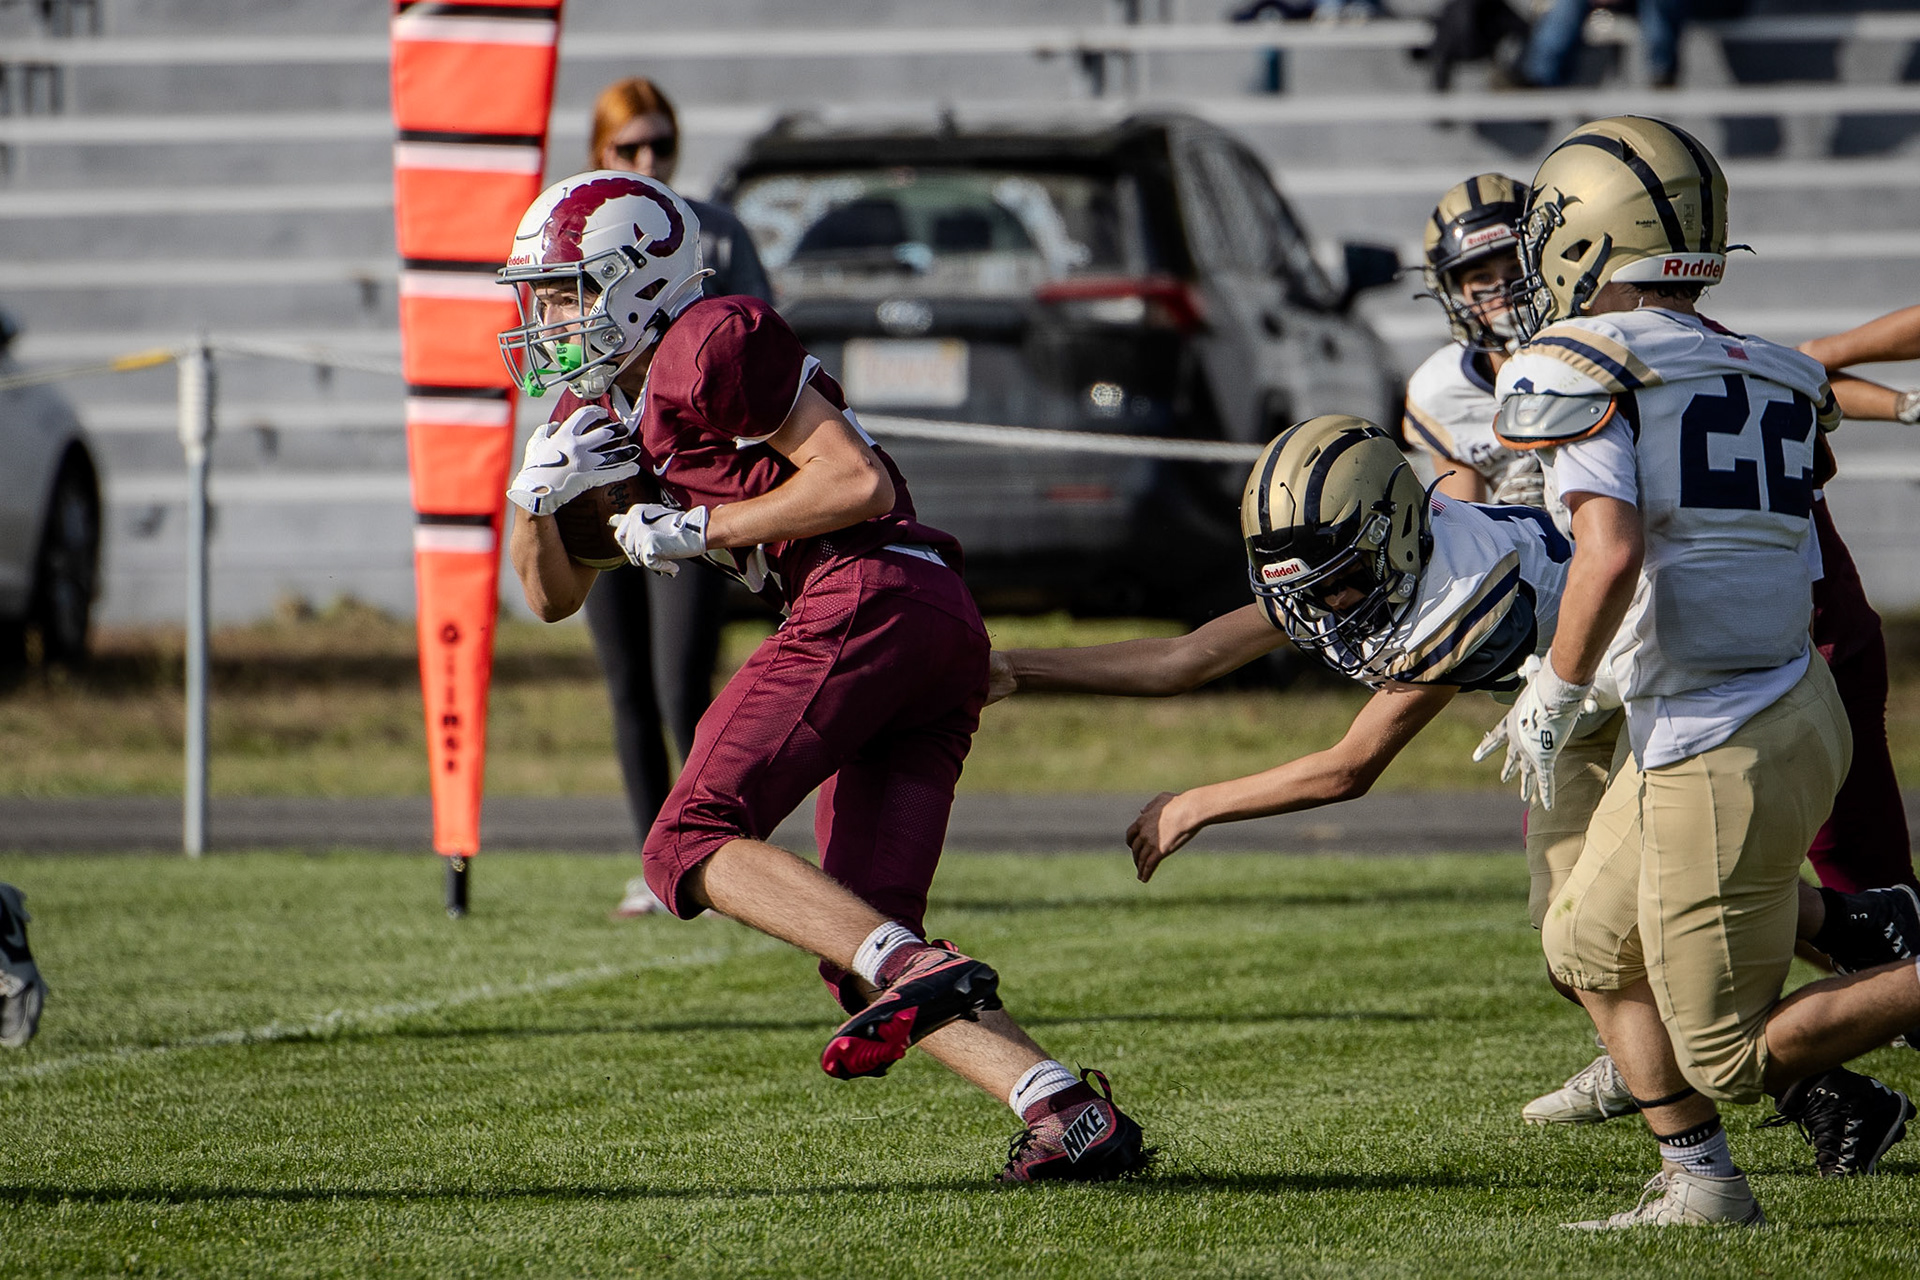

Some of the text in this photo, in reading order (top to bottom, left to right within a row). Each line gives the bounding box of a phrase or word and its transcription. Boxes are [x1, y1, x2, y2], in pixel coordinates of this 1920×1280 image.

[1679, 373, 1814, 520] 22
[1264, 563, 1301, 579] Riddell
[1061, 1104, 1106, 1162] NIKE
